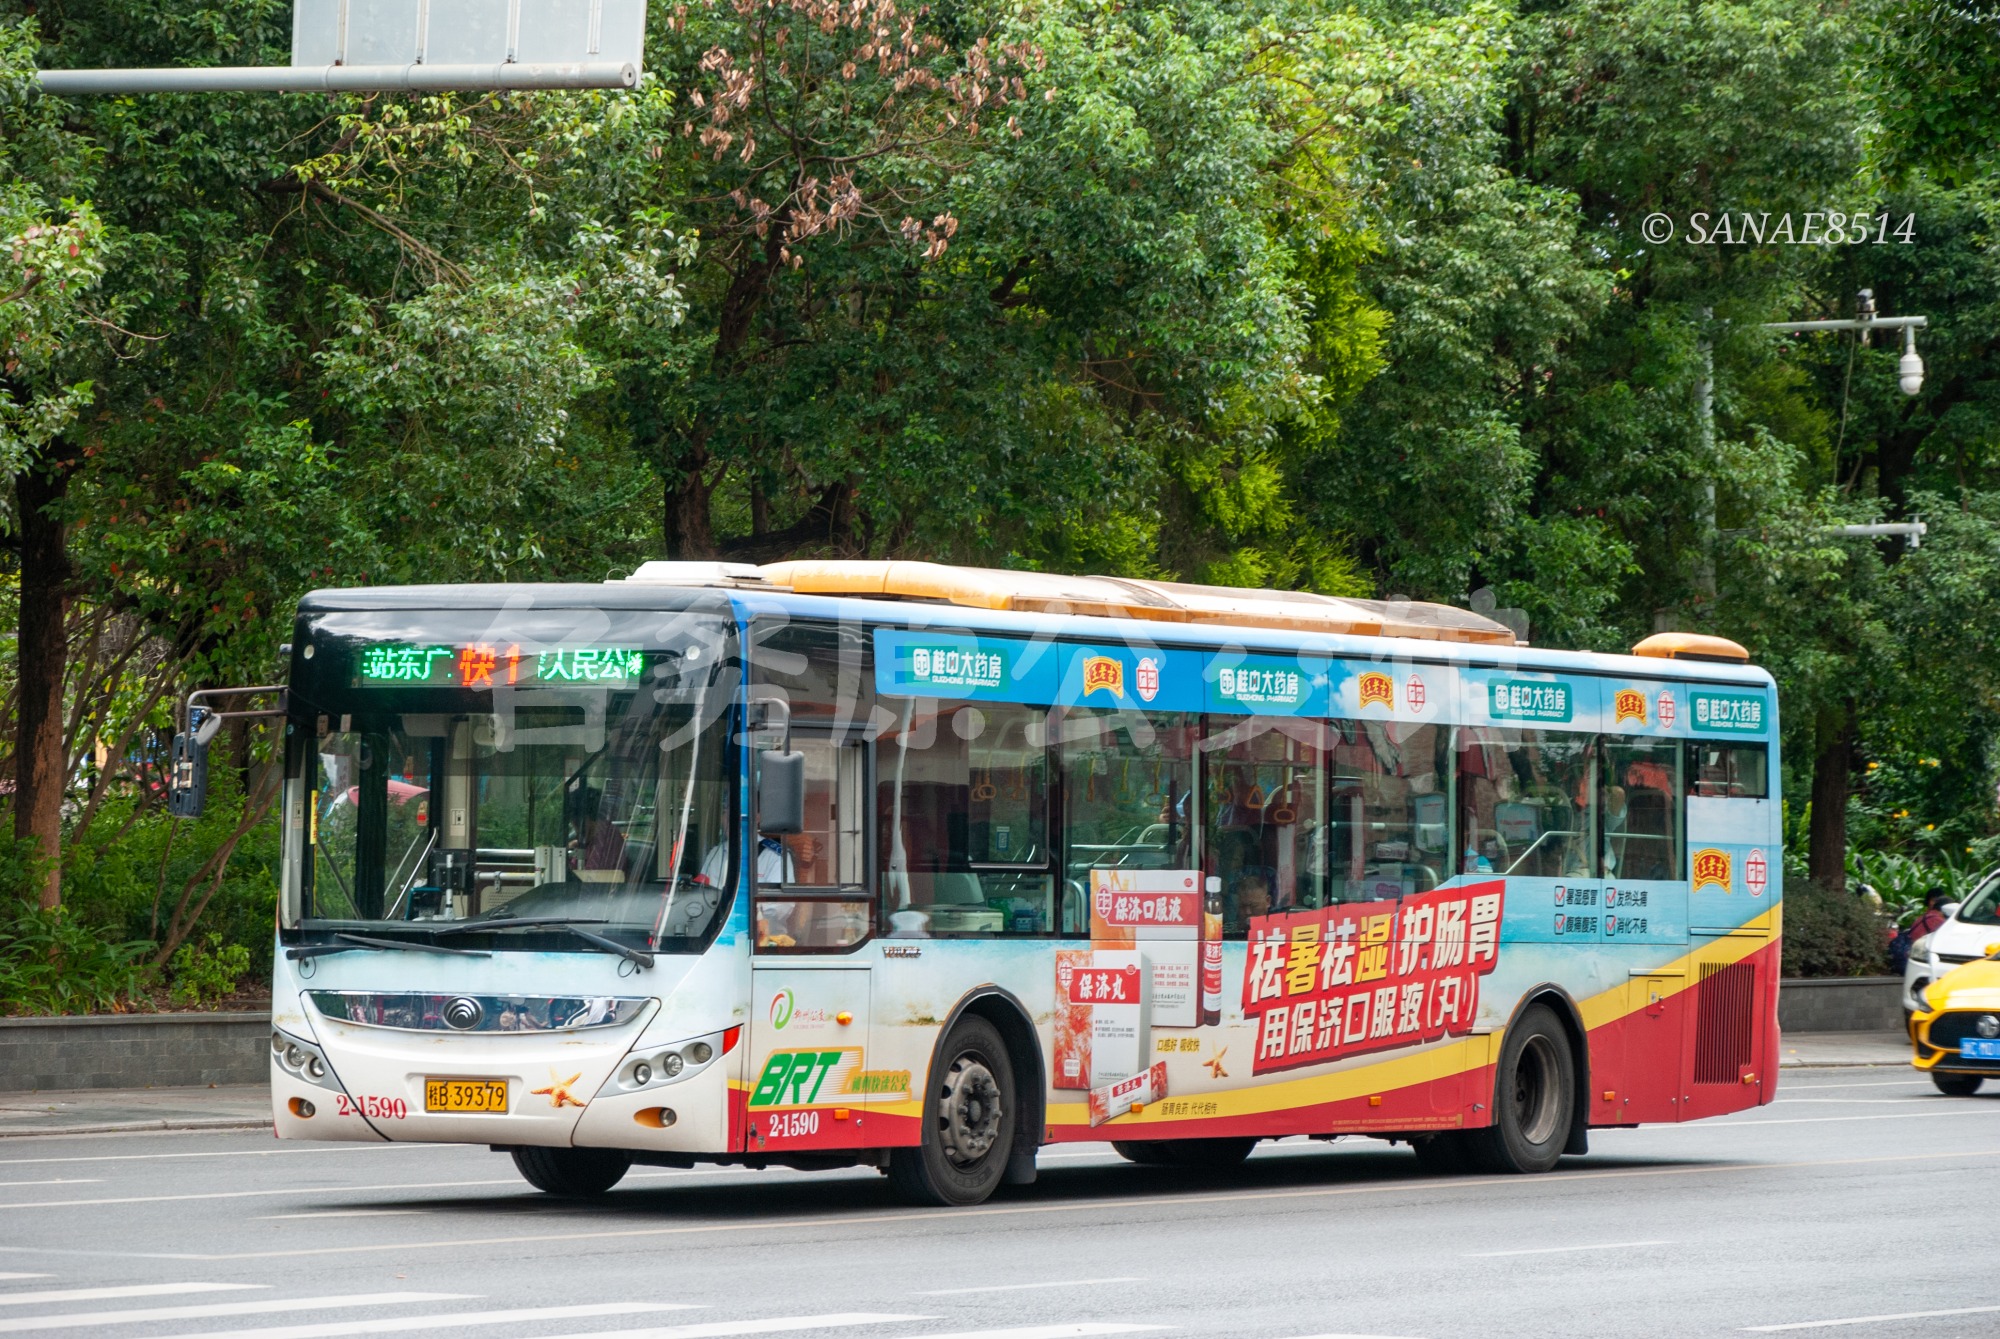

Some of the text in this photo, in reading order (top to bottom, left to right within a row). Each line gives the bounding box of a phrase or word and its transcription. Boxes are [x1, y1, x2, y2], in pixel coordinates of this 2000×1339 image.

[363, 648, 454, 679] 站东广
[932, 649, 1002, 679] 桂中大药房
[1236, 669, 1299, 695] 桂中大药房
[1510, 686, 1565, 711] 桂中大药房
[1710, 699, 1761, 723] 桂中大药房
[1114, 896, 1184, 922] 保济口服液
[1616, 890, 1648, 907] 发热头痛
[1616, 918, 1648, 934] 消化不良
[1249, 892, 1502, 1004] 祛暑祛湿 护肠胃
[1078, 972, 1127, 1000] 保济丸
[1157, 1037, 1200, 1052] 口感好 吸收快
[749, 1052, 842, 1106] BRT
[336, 1094, 407, 1120] 2-1590
[1161, 1102, 1218, 1115] 肠胃良药 代代相传
[769, 1111, 819, 1137] 2-1590
